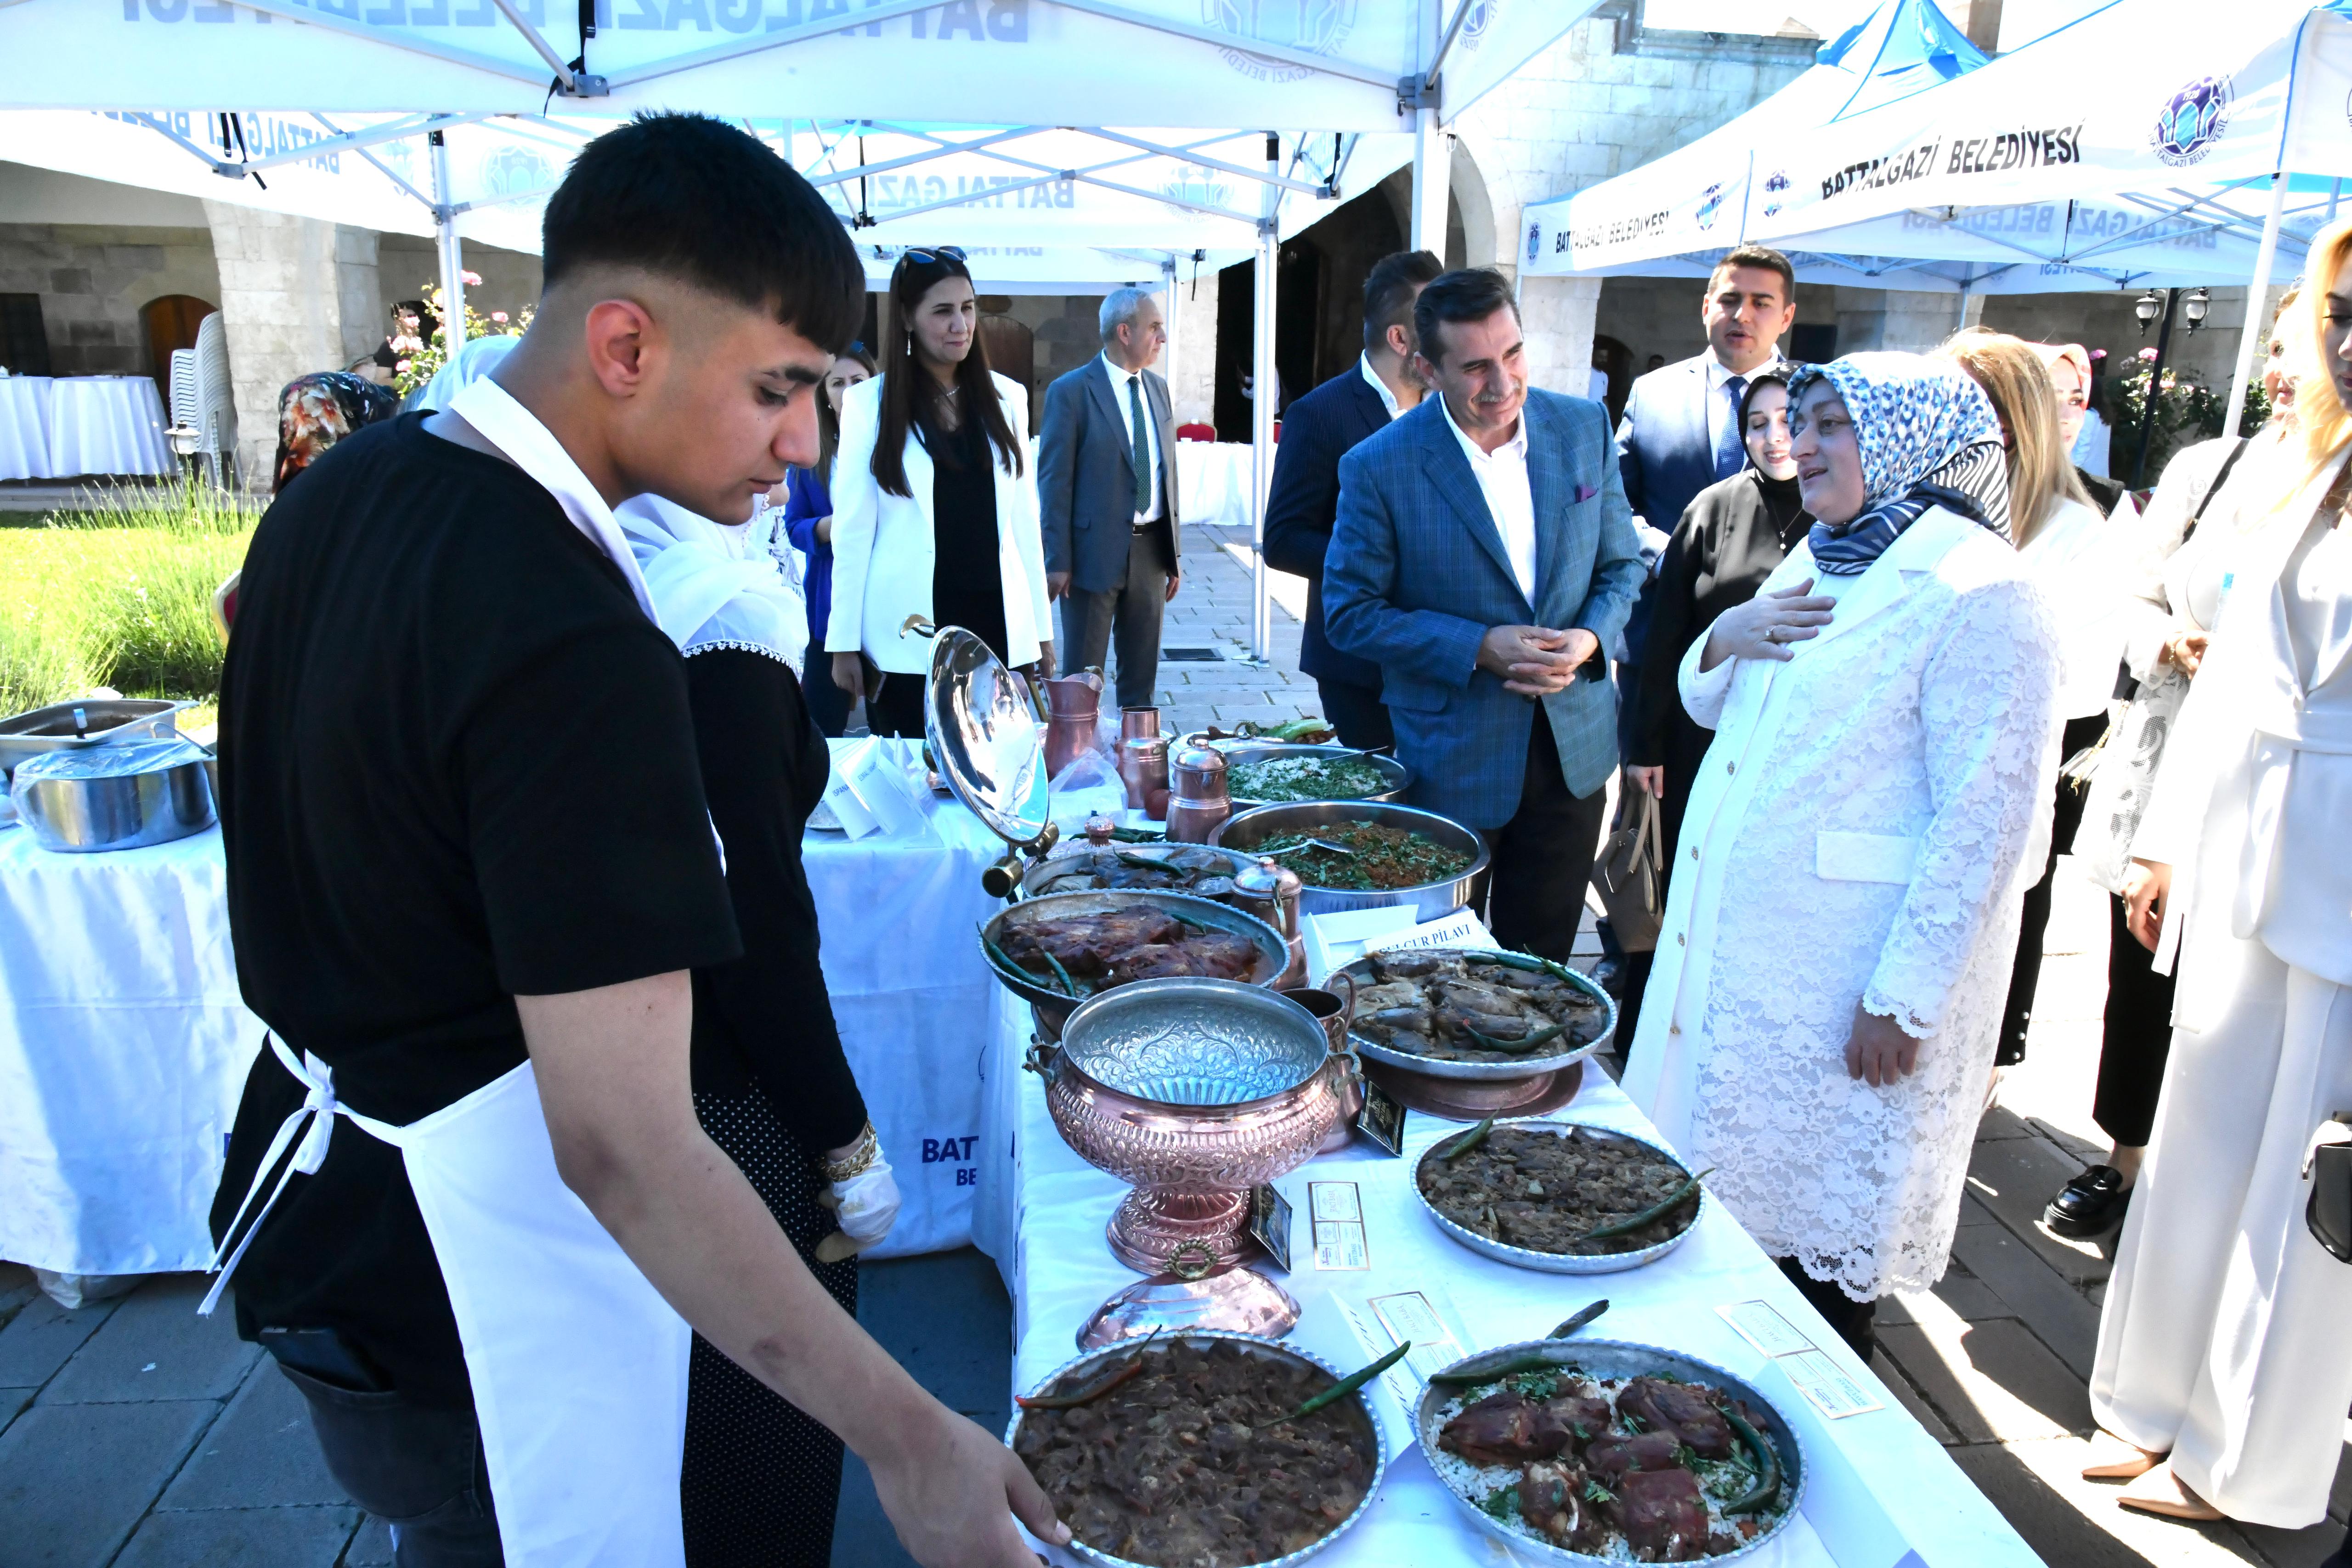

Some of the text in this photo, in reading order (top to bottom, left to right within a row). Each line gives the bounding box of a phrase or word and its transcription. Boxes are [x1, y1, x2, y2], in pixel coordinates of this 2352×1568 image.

[1821, 117, 2086, 200] BATTALGAZİ BELEDİYESİ
[833, 784, 849, 796] ISPANA
[1432, 924, 1470, 944] PİLAVI
[922, 1136, 979, 1163] BAT
